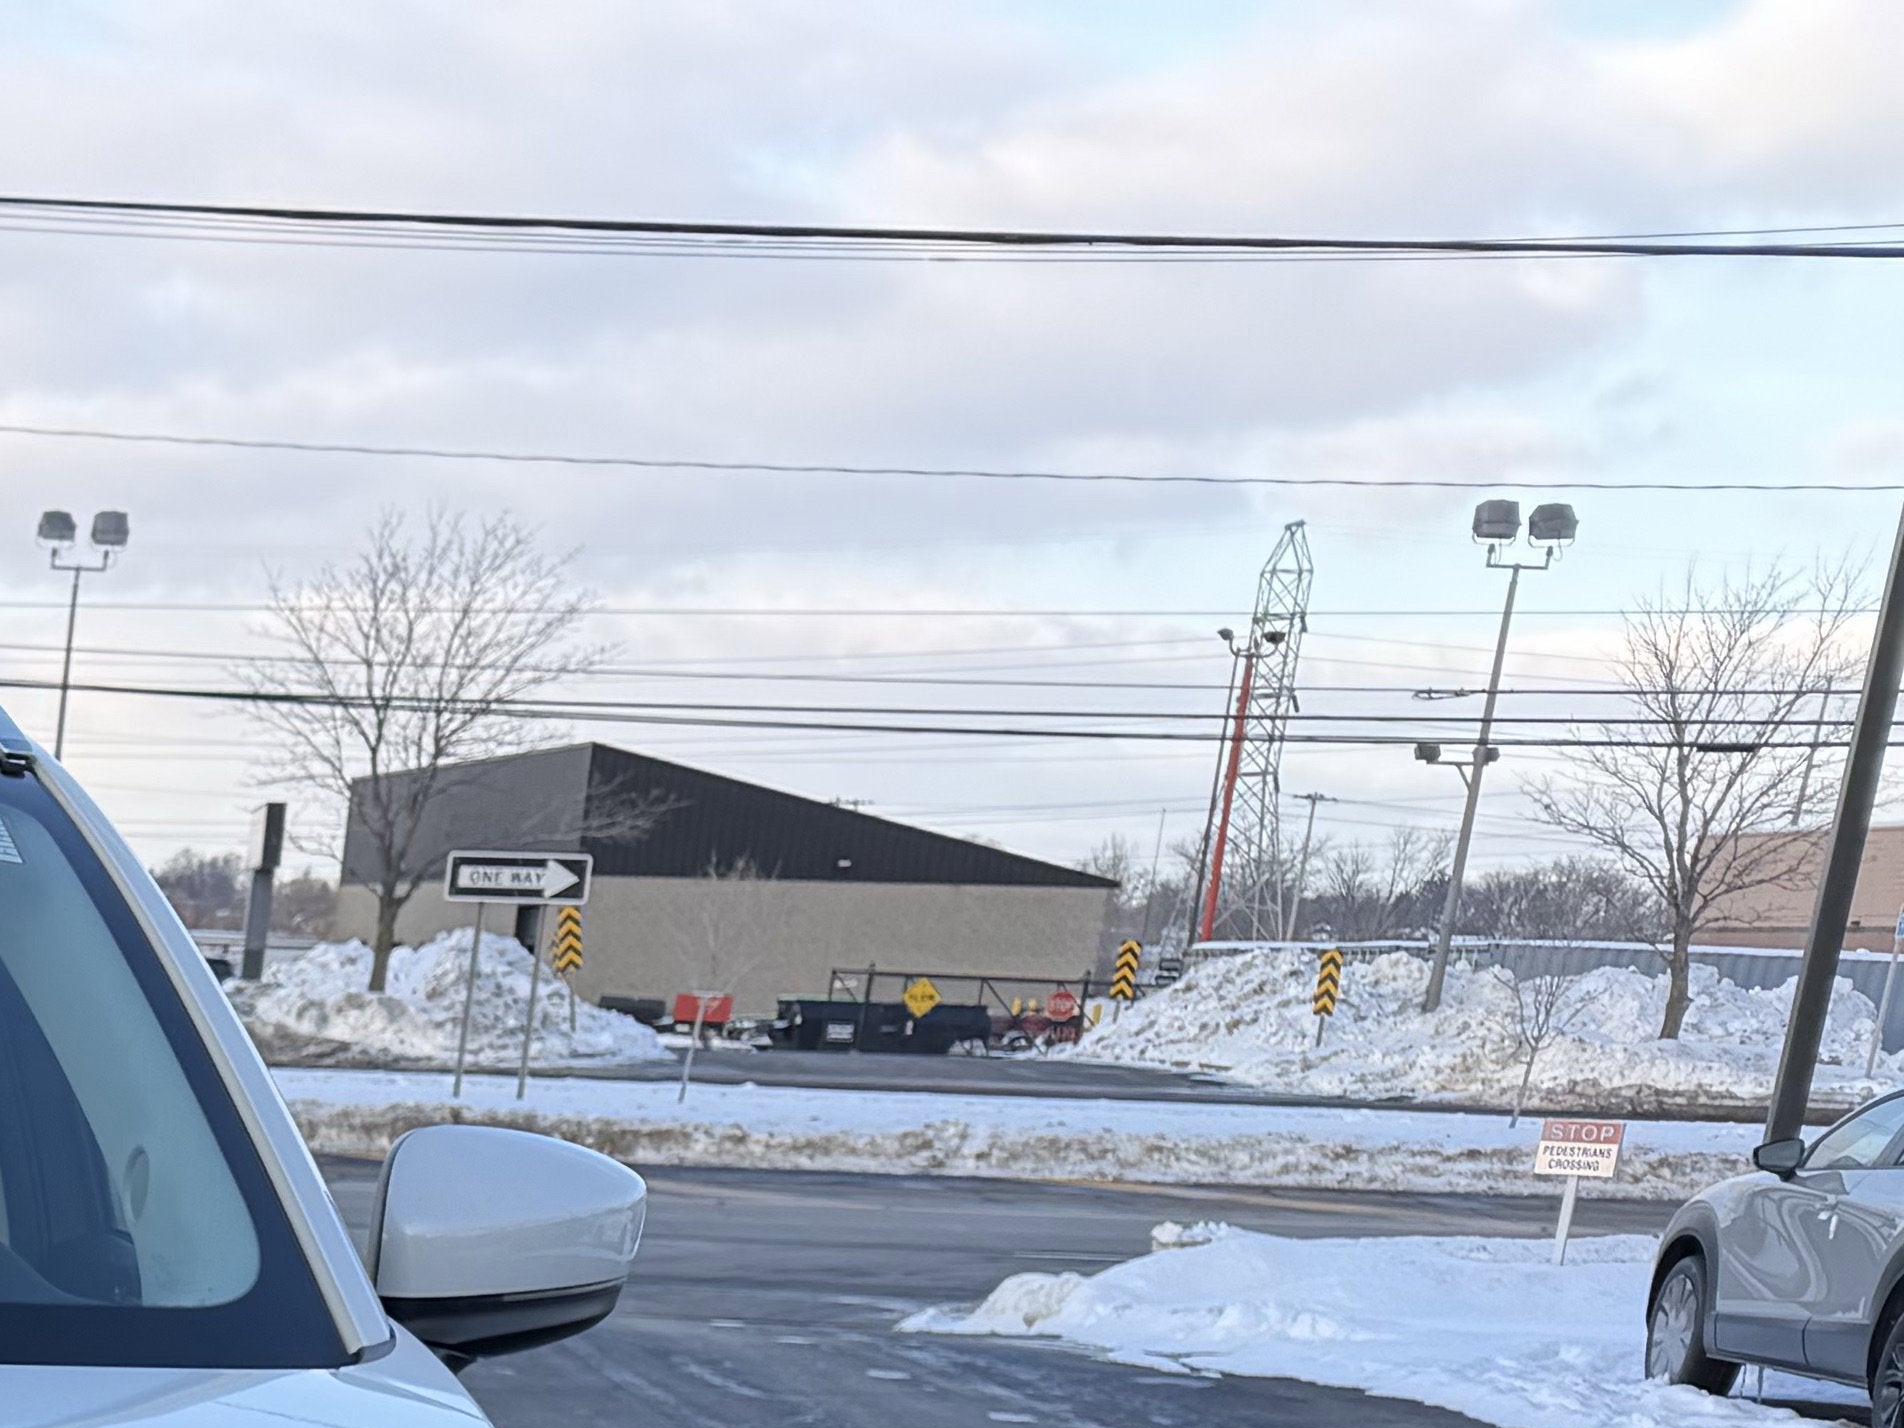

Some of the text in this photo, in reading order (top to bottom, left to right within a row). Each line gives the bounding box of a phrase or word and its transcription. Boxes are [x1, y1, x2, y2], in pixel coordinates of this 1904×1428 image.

[470, 871, 545, 885] ONE WAY
[1551, 1124, 1614, 1142] STOP
[1543, 1145, 1612, 1158] PEDESTRIANS
[1548, 1159, 1600, 1172] CROSSING
